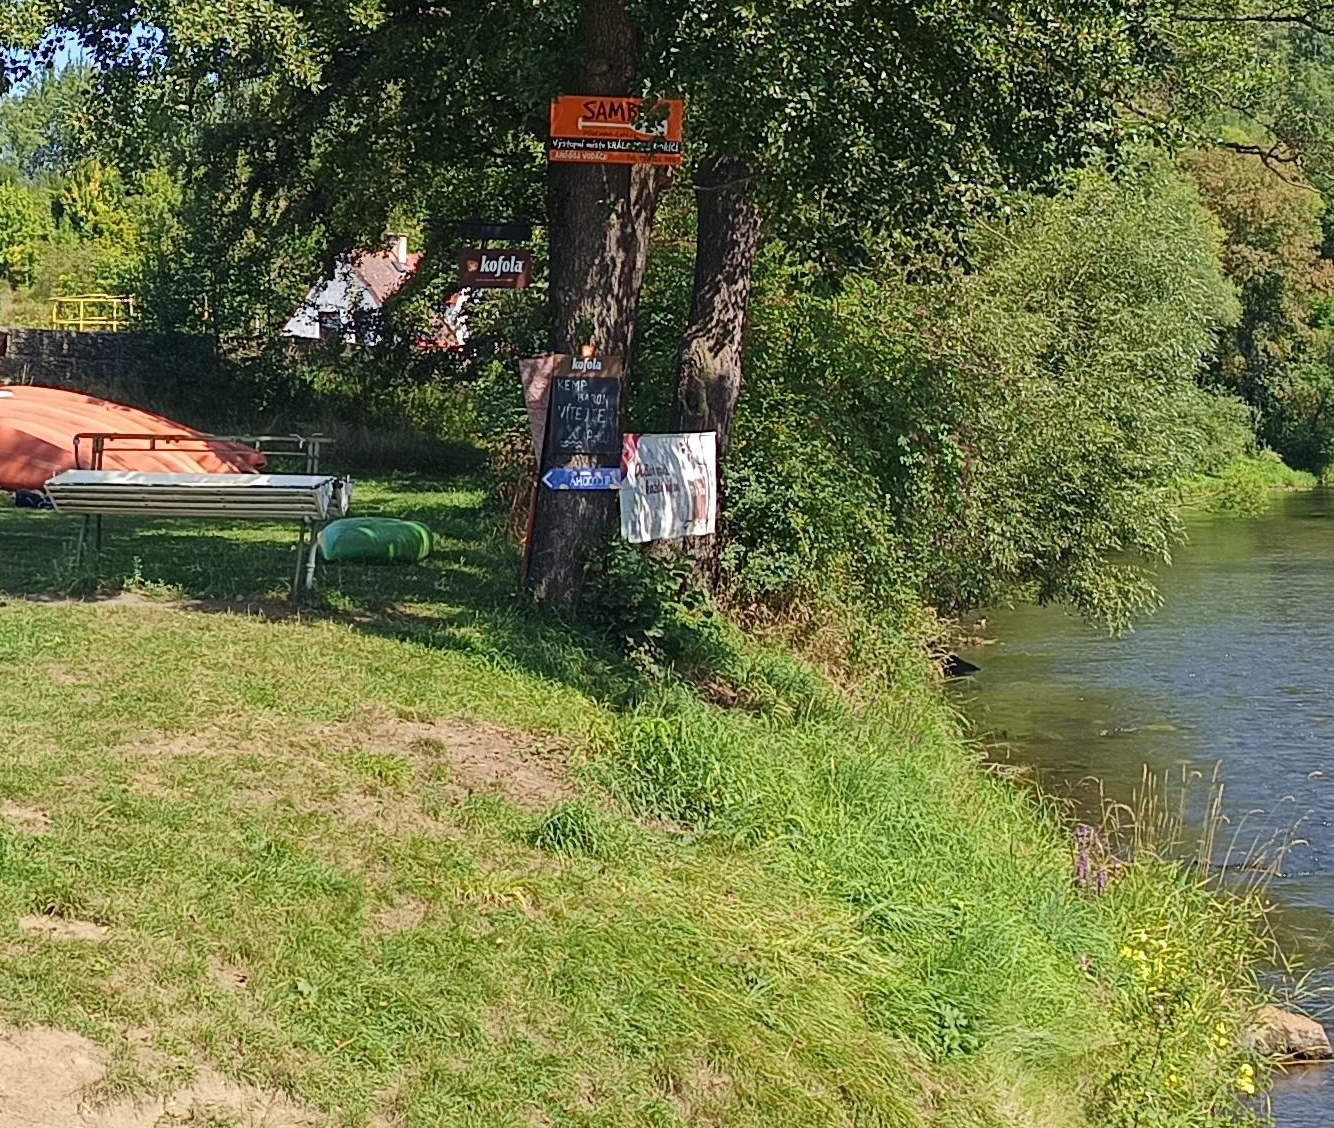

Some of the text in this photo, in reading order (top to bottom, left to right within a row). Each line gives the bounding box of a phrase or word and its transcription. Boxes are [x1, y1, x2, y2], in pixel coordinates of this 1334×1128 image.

[582, 101, 671, 123] SAMB
[480, 255, 525, 277] kofola
[571, 357, 602, 372] kofola
[557, 379, 588, 392] KEMP
